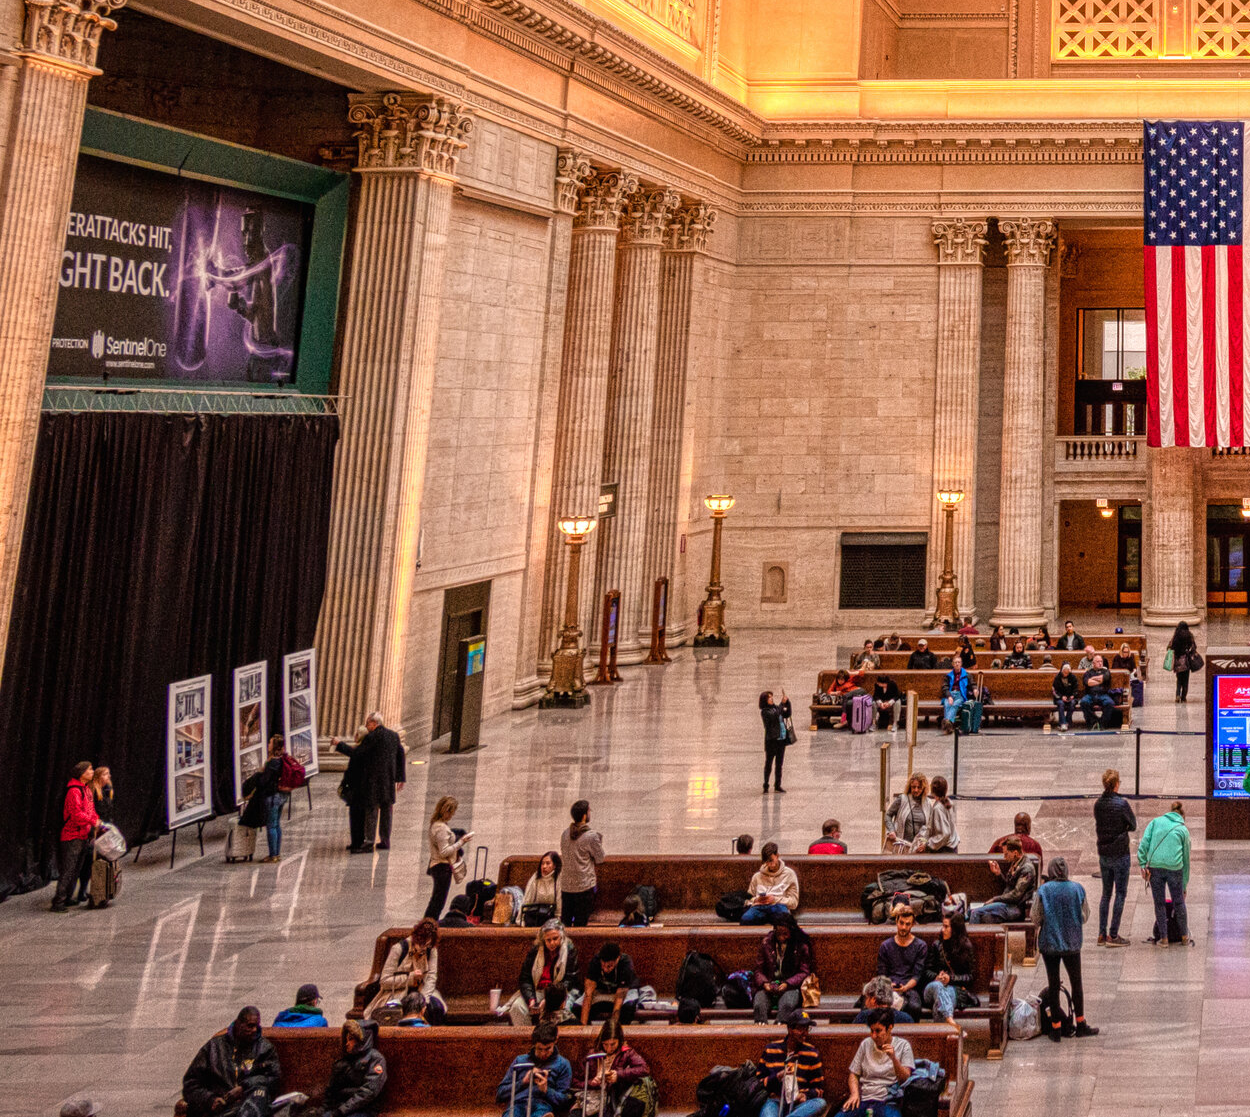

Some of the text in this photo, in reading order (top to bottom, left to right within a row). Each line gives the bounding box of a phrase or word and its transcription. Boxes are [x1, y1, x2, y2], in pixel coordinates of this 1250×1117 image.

[67, 212, 172, 253] ERATTACKS HIT,
[59, 250, 170, 297] GHT BACK.
[52, 338, 89, 348] PROTECTION
[106, 336, 167, 357] SentinelOne
